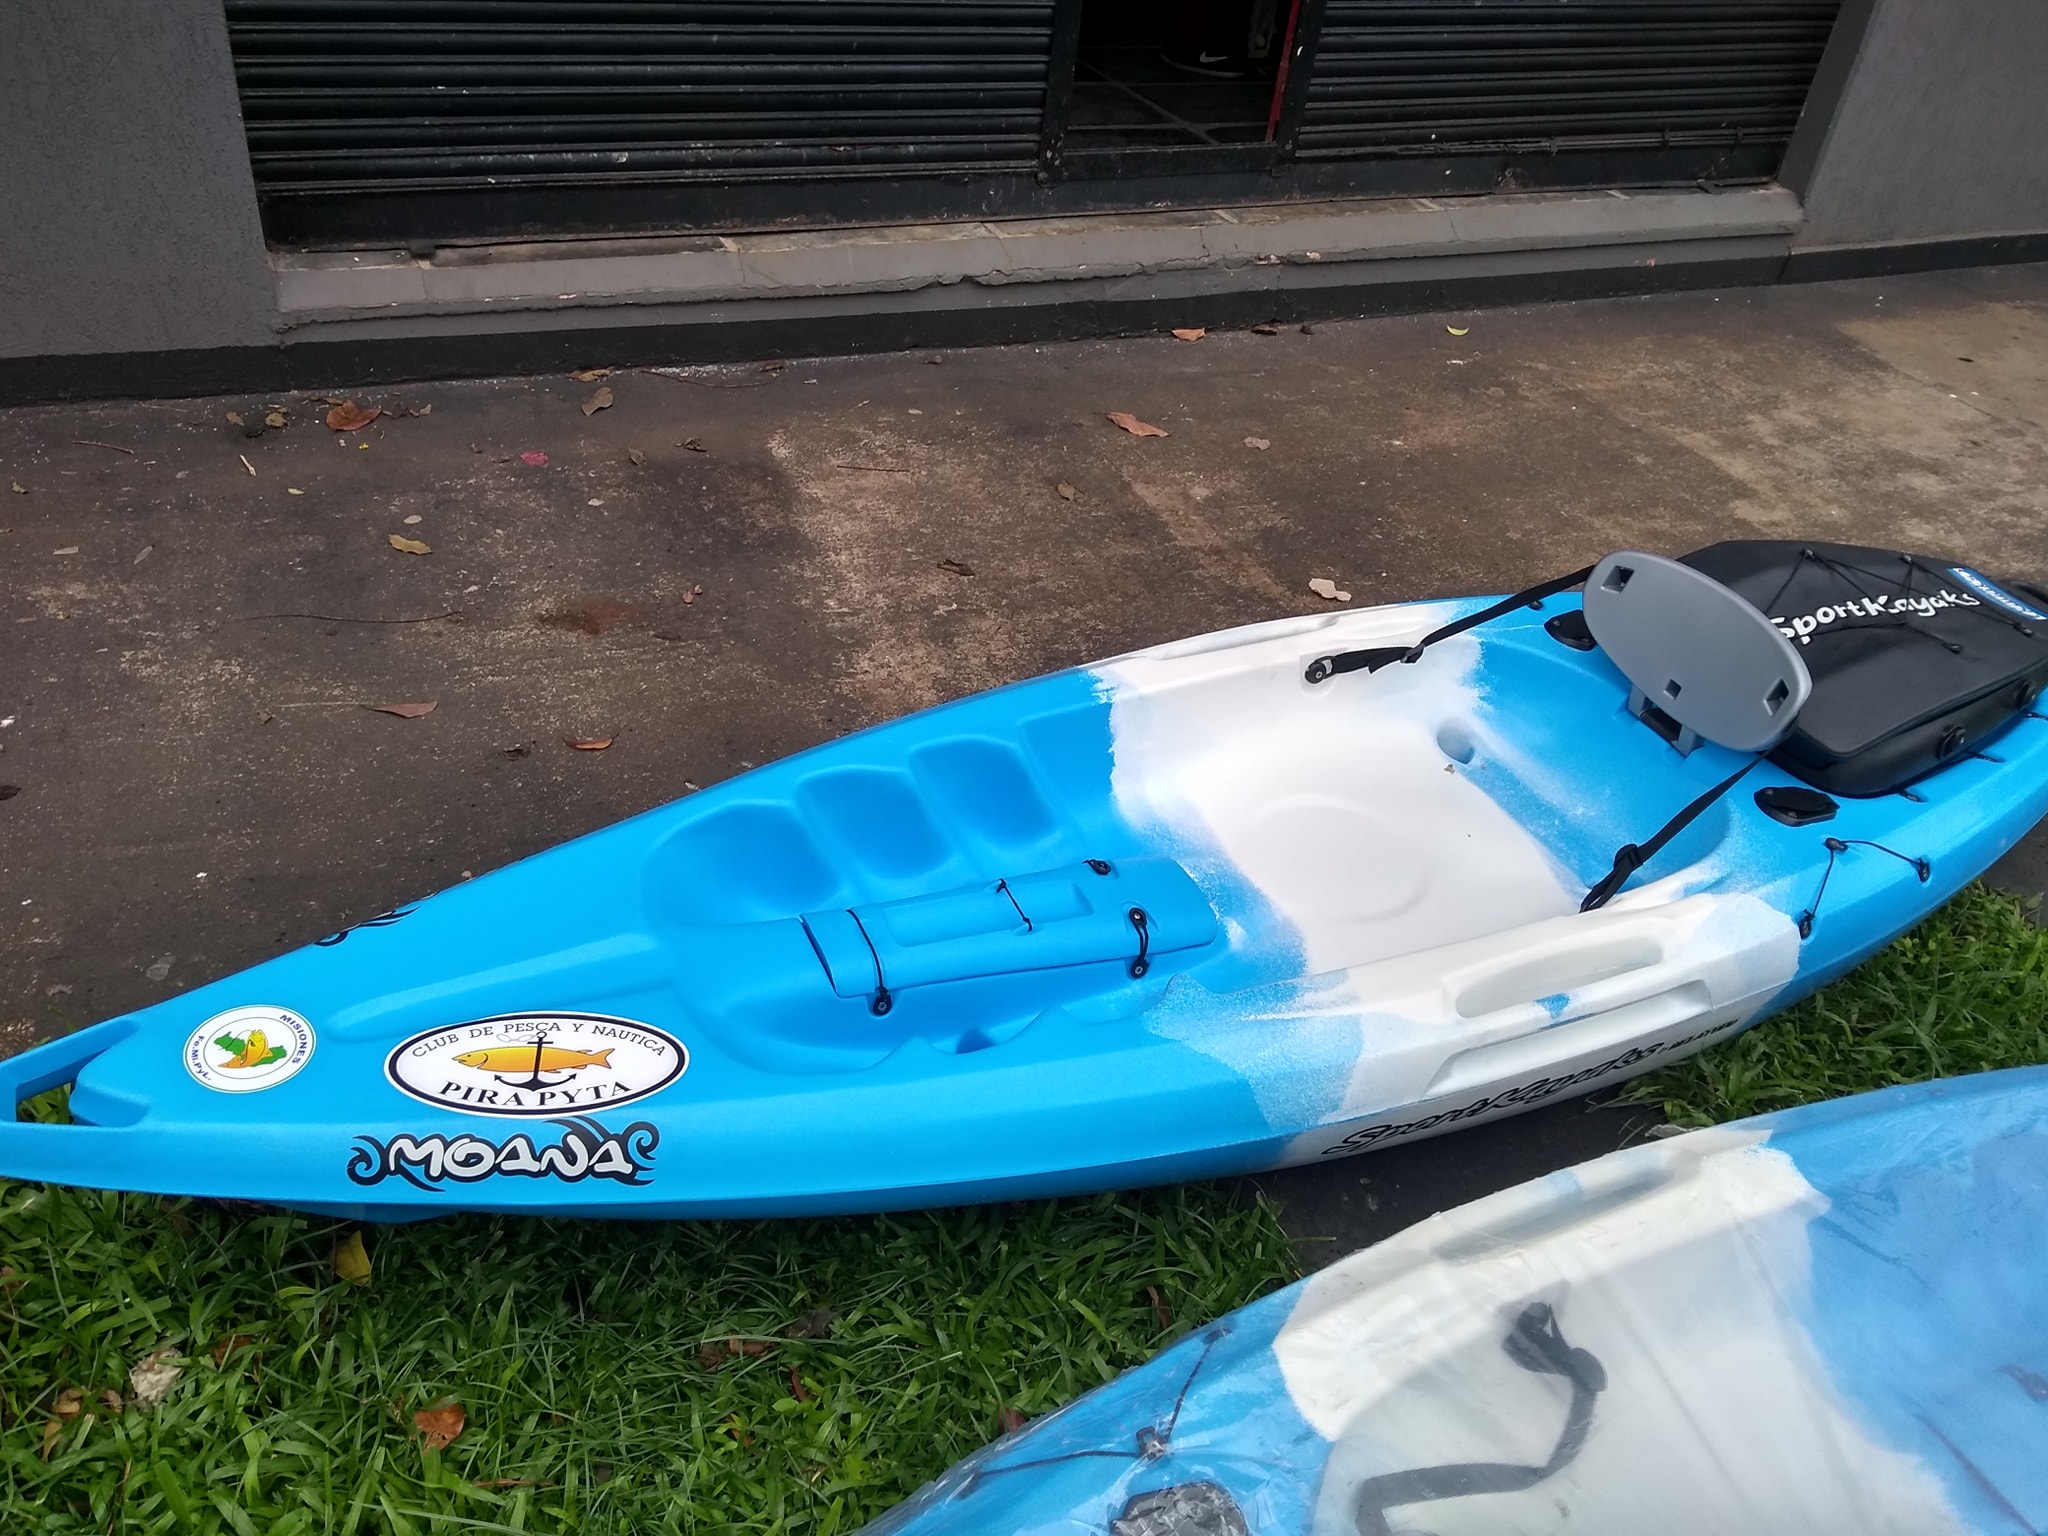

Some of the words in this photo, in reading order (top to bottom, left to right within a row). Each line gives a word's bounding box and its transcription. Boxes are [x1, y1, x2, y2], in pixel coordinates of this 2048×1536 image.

[279, 1013, 308, 1065] MISIONES
[412, 1033, 459, 1058] CLUB
[469, 1026, 494, 1039] DE
[503, 1022, 562, 1034] PESCA
[572, 1022, 585, 1033] Y
[591, 1024, 667, 1057] NAUTICA
[438, 1080, 525, 1107] PIRA
[538, 1080, 633, 1107] PYTA
[385, 1132, 638, 1183] MOANA
